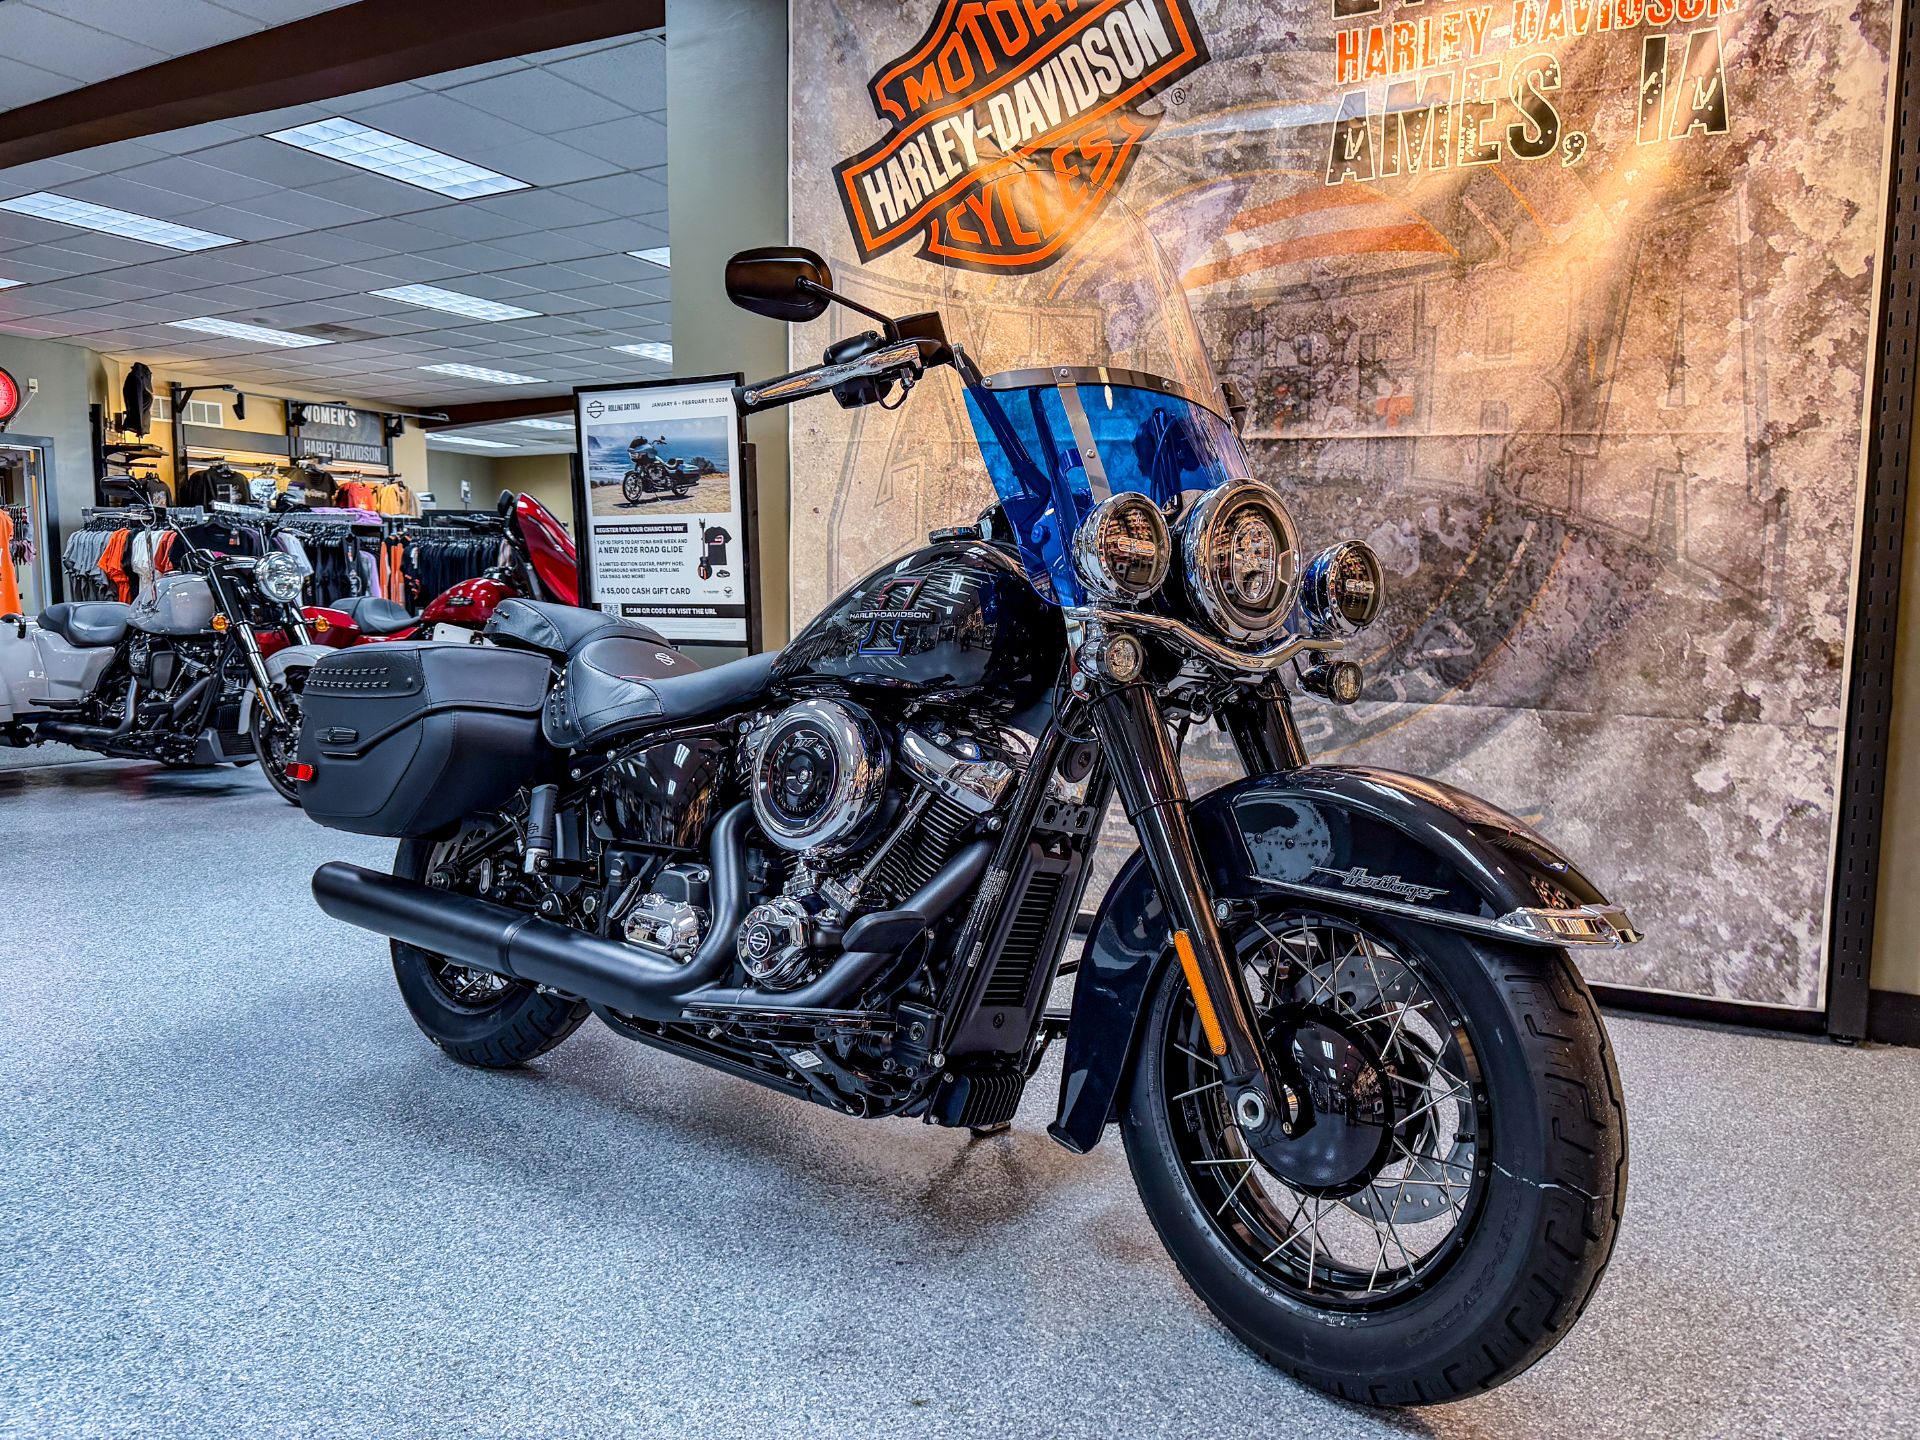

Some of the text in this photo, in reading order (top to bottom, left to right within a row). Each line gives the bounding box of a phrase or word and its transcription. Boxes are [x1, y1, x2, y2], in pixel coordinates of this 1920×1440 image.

[1325, 52, 1588, 186] AMES,
[1636, 26, 1730, 146] IA
[862, 10, 1173, 230] HARLEY-DAVIDSON
[946, 126, 1114, 246] CYCLES
[682, 398, 707, 406] FEBRUARY
[303, 439, 381, 463] HARLEY-DAVIDSON
[598, 546, 603, 554] A
[604, 546, 619, 554] NEW
[621, 546, 638, 554] 2026
[640, 546, 659, 554] ROAD
[601, 587, 690, 595] A $5,000 CASH GIFT CARD
[850, 611, 930, 620] HARLEY-DAVIDSON
[1343, 866, 1435, 902] Heritage
